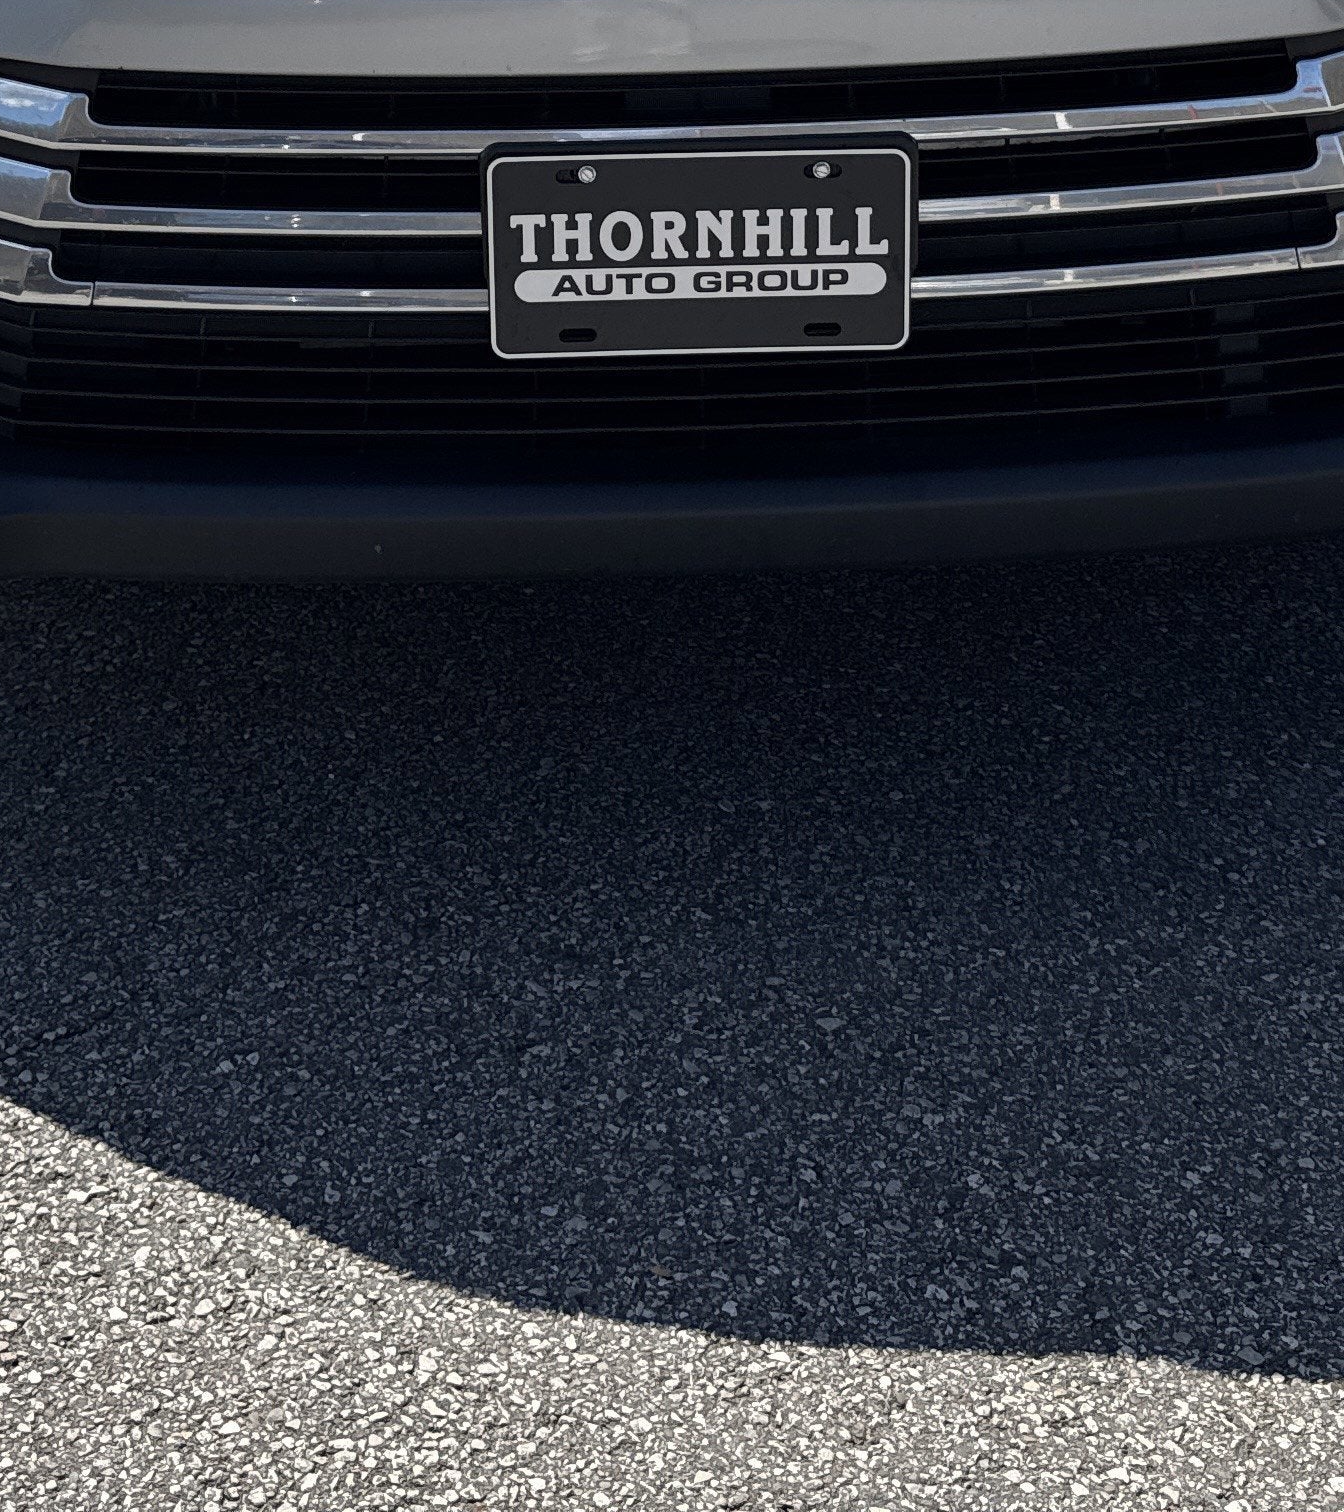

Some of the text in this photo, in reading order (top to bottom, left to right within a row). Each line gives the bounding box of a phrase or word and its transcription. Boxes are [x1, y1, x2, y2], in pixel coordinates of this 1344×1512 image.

[509, 206, 889, 263] THORNHILL
[551, 268, 849, 297] AUTO GROUP
